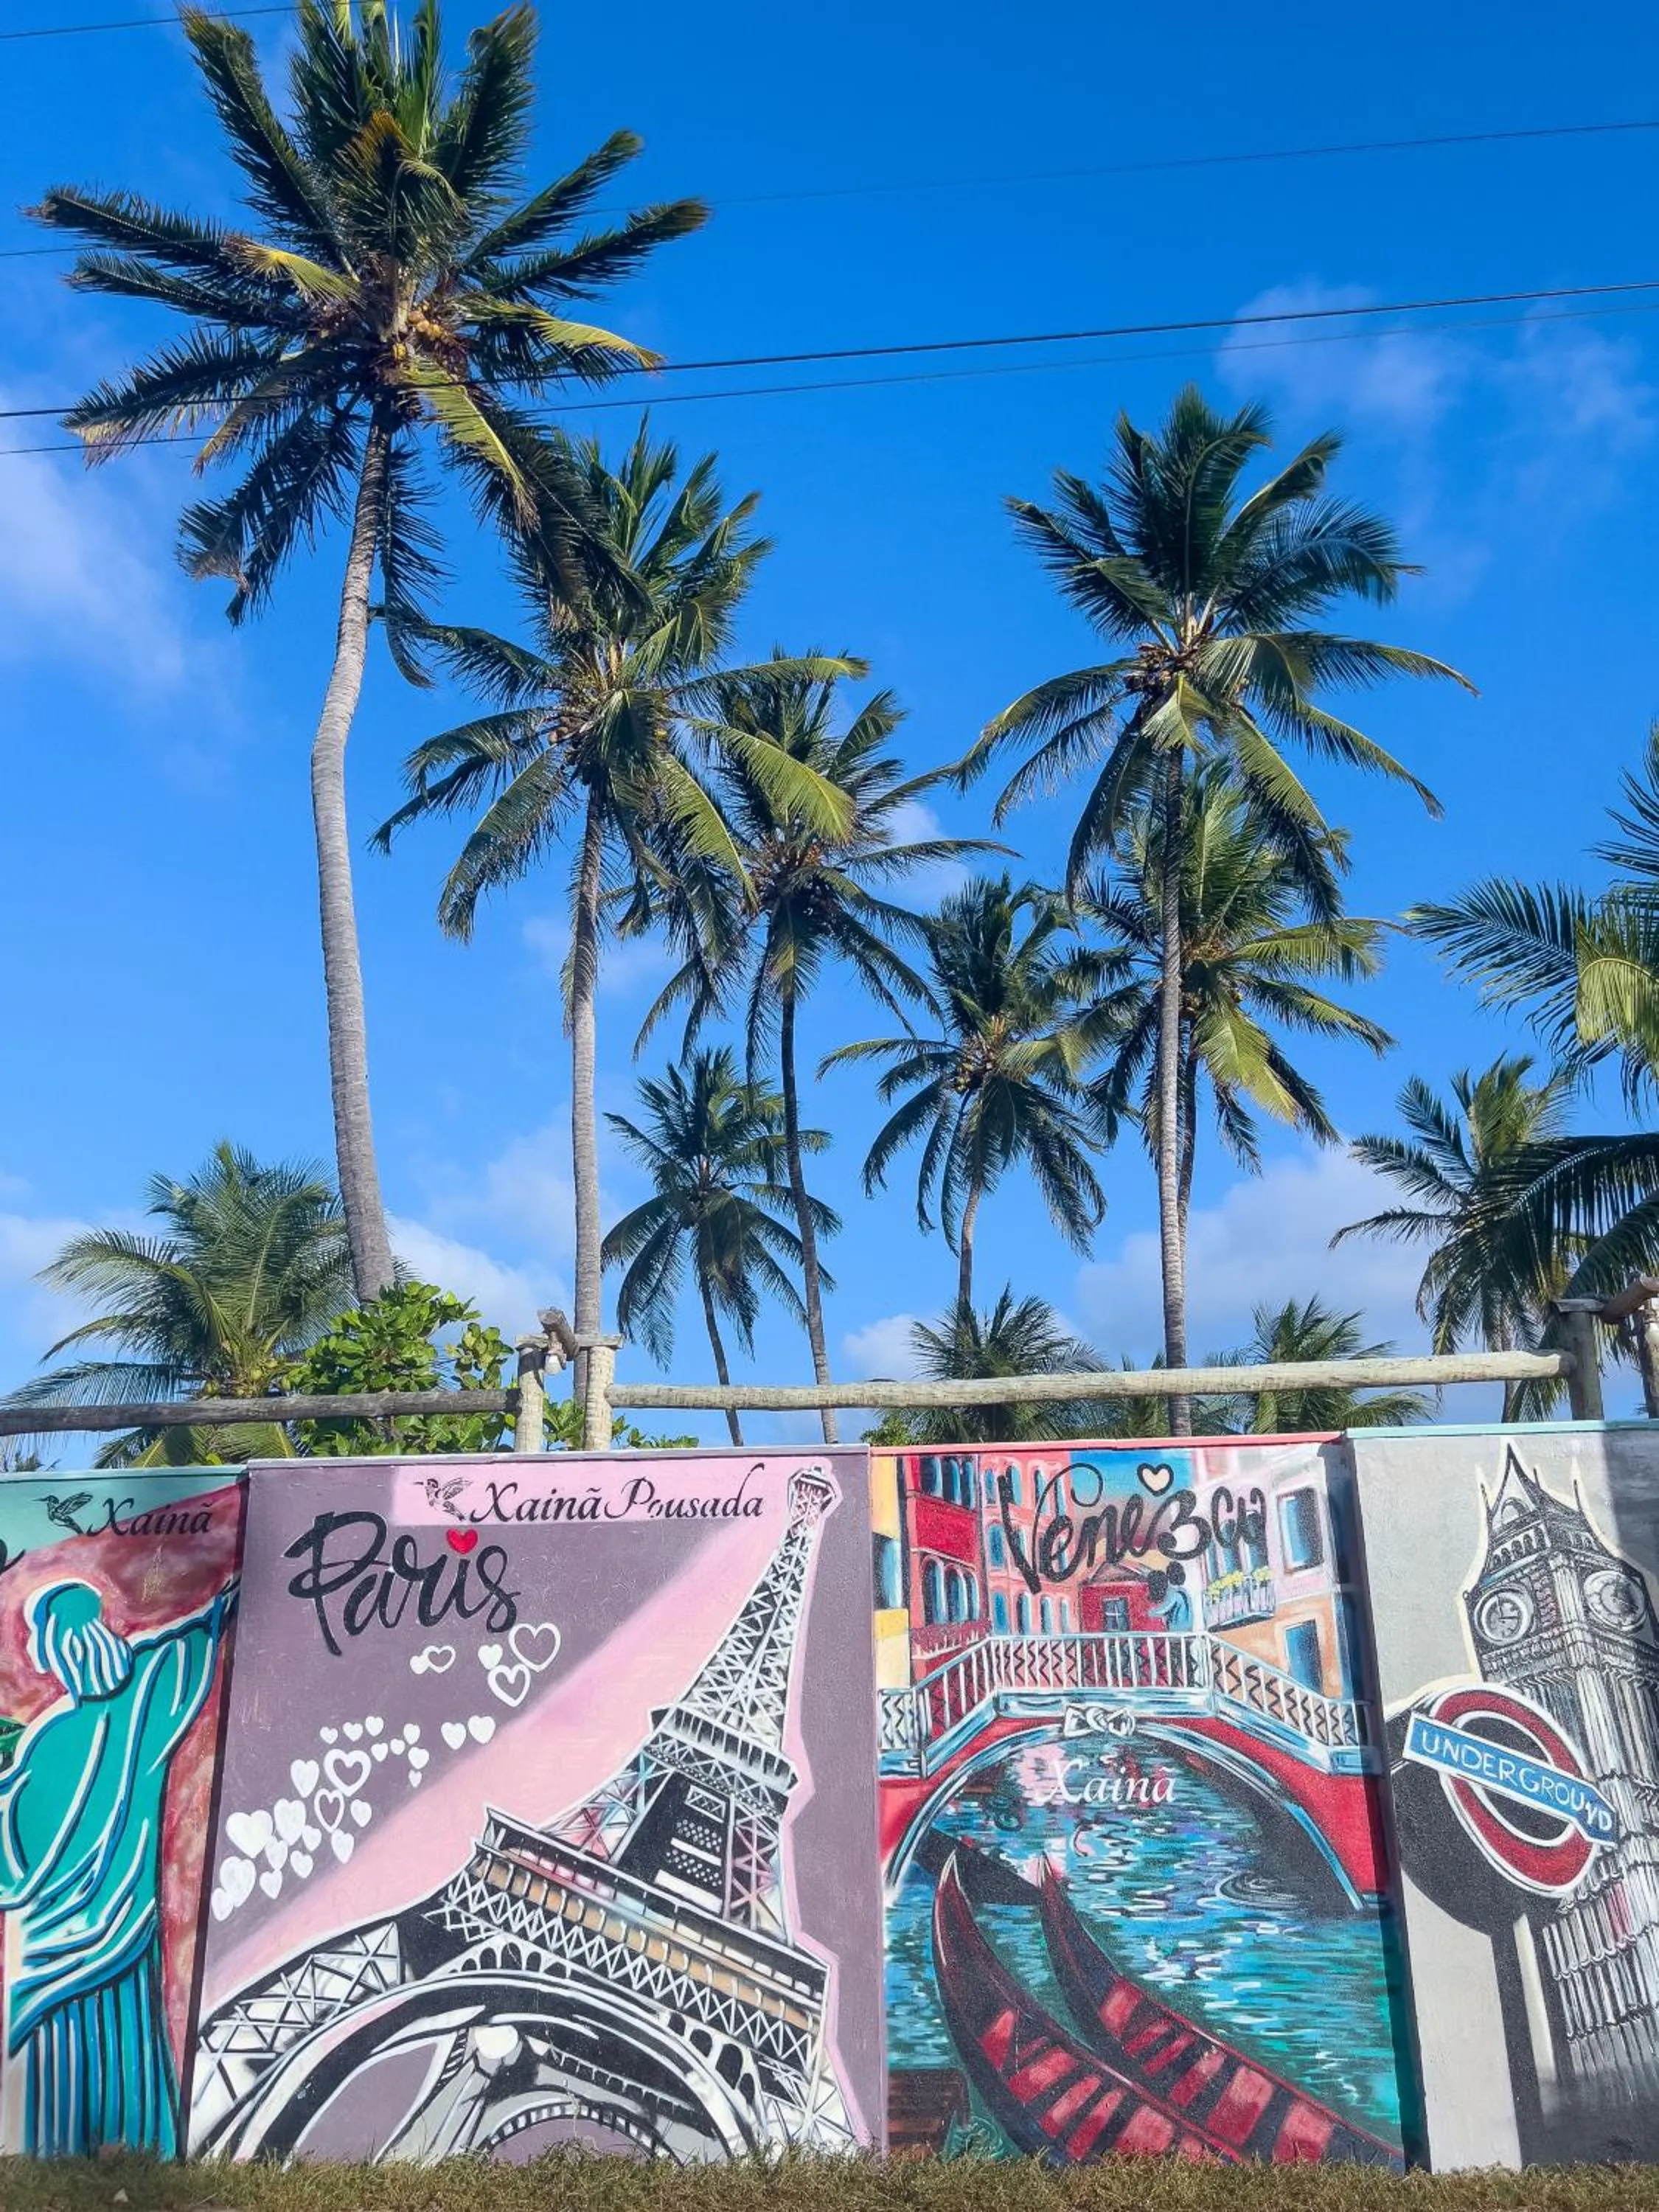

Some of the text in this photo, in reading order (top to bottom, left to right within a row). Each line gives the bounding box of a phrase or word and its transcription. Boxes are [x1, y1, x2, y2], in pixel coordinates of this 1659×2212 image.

[86, 1498, 214, 1537] Xainã
[469, 1463, 765, 1523] Xainã Pousada
[283, 1511, 521, 1657] Paris
